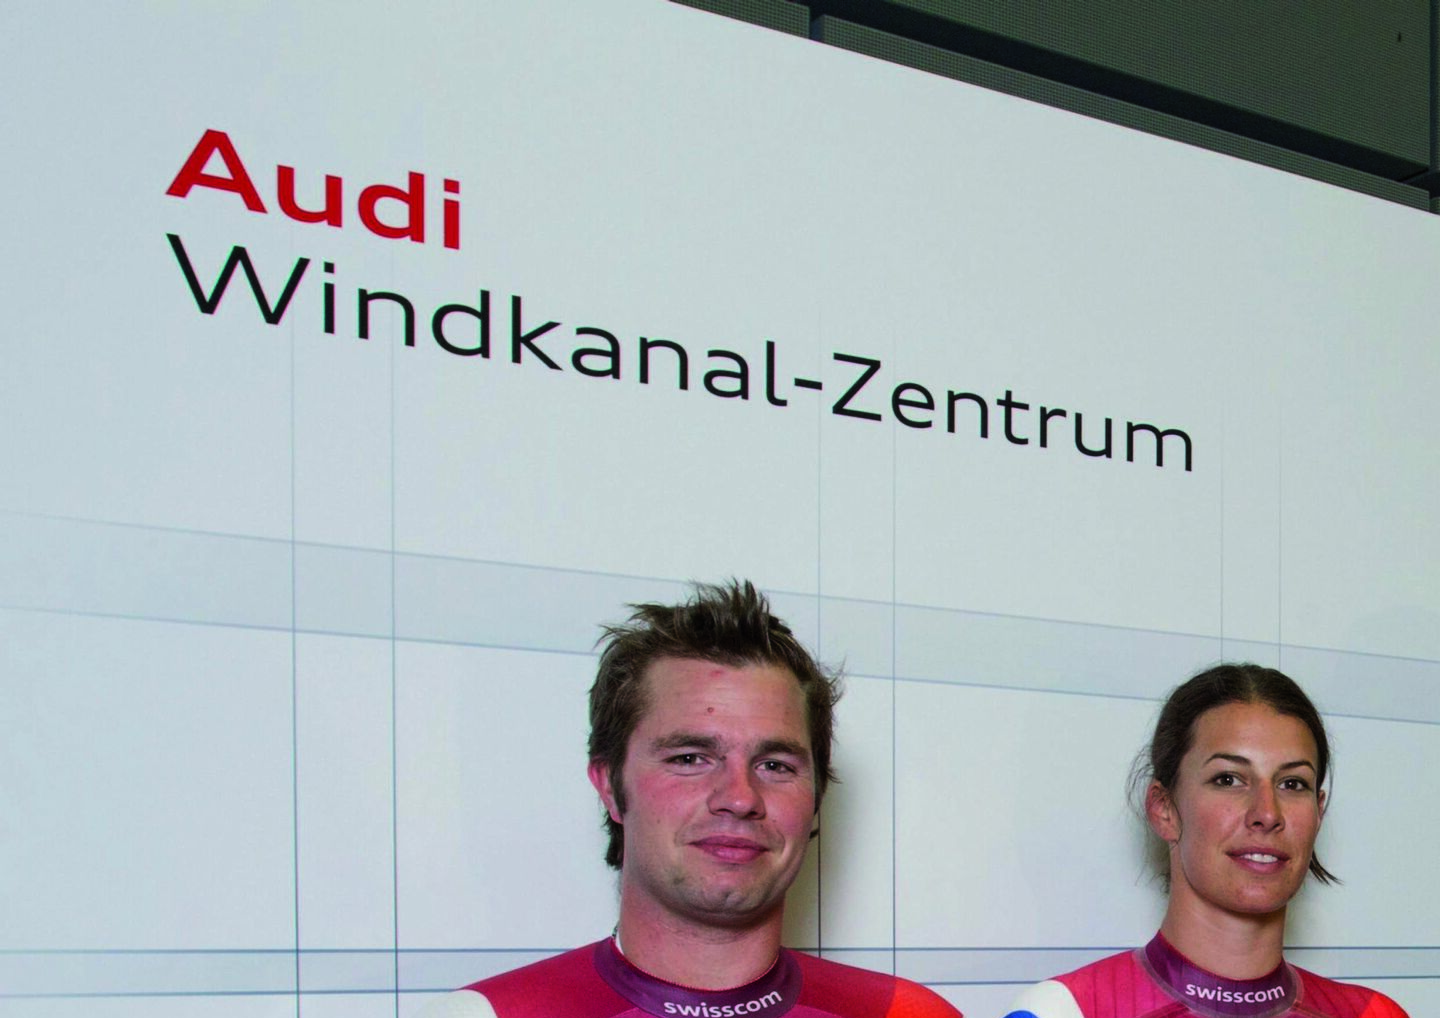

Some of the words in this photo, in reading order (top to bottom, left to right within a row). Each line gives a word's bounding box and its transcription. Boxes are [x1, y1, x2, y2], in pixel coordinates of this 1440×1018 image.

[165, 128, 462, 250] Audi
[166, 232, 1194, 472] Windkanal-Zentrum
[663, 990, 783, 1018] swisscom
[1185, 981, 1286, 1004] swisscom
